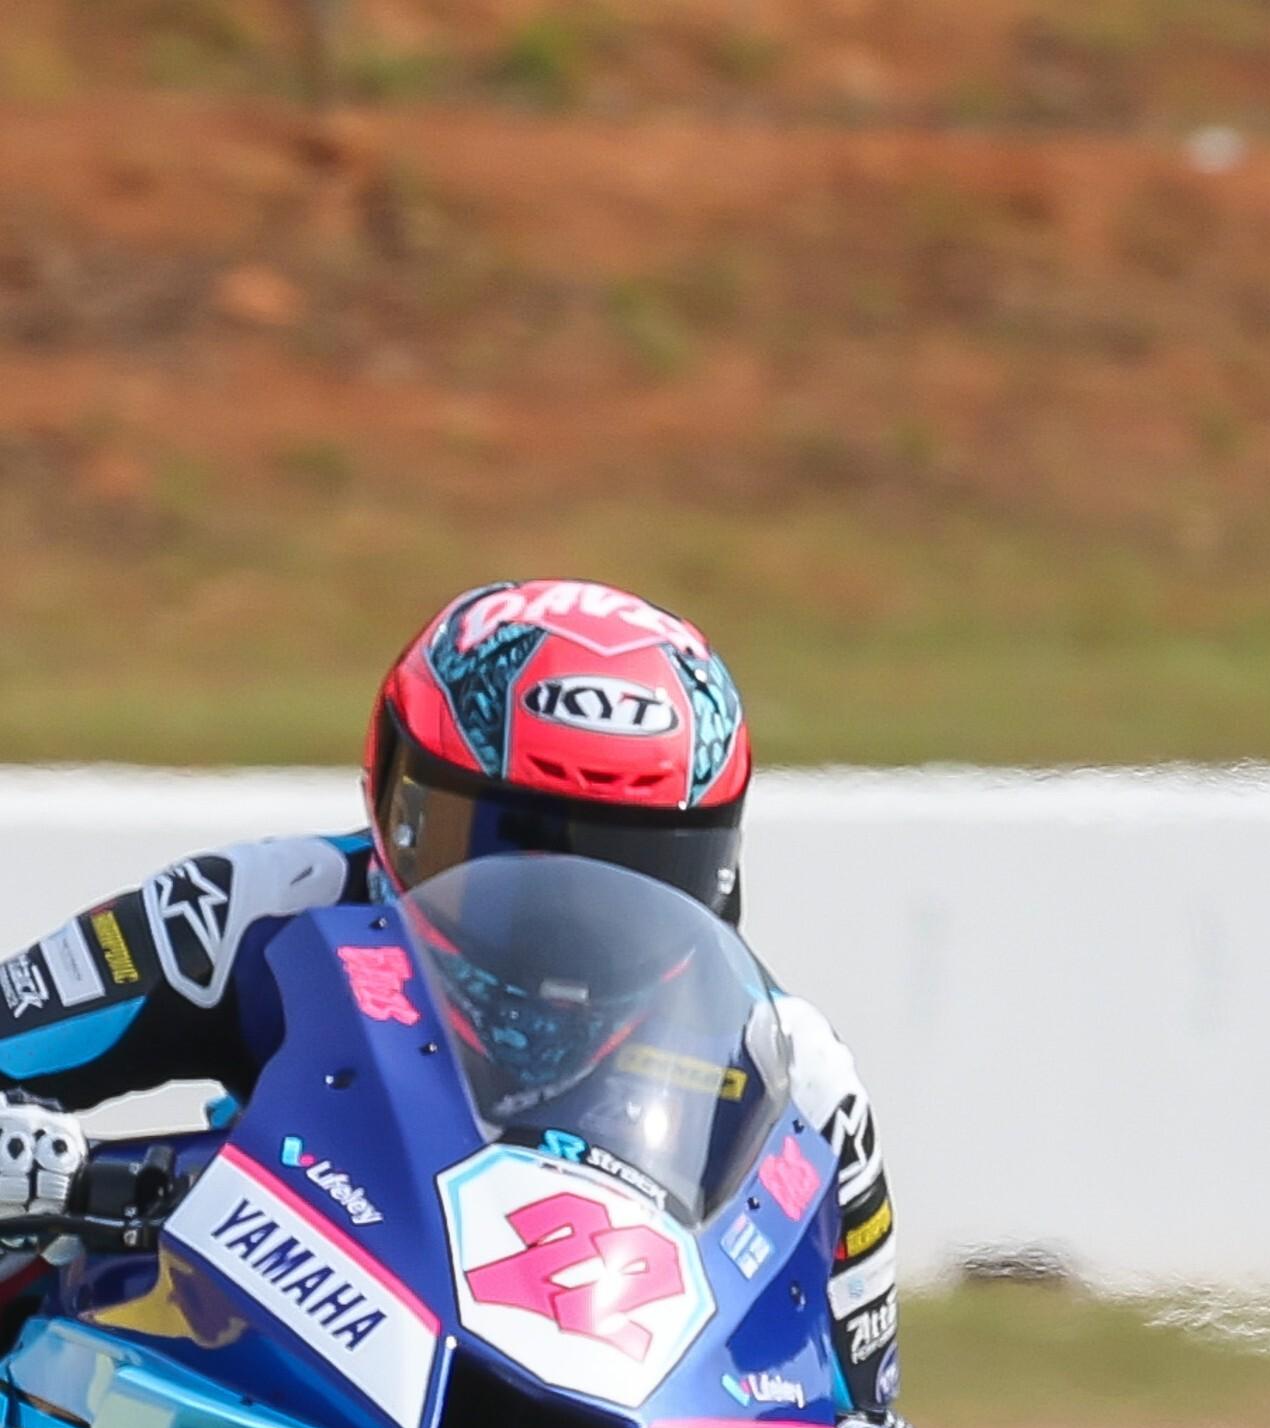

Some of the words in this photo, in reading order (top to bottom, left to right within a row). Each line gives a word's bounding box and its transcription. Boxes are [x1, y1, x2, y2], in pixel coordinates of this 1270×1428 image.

[540, 683, 662, 726] KYT
[211, 1197, 388, 1352] YAMAHA
[464, 1191, 685, 1364] 22
